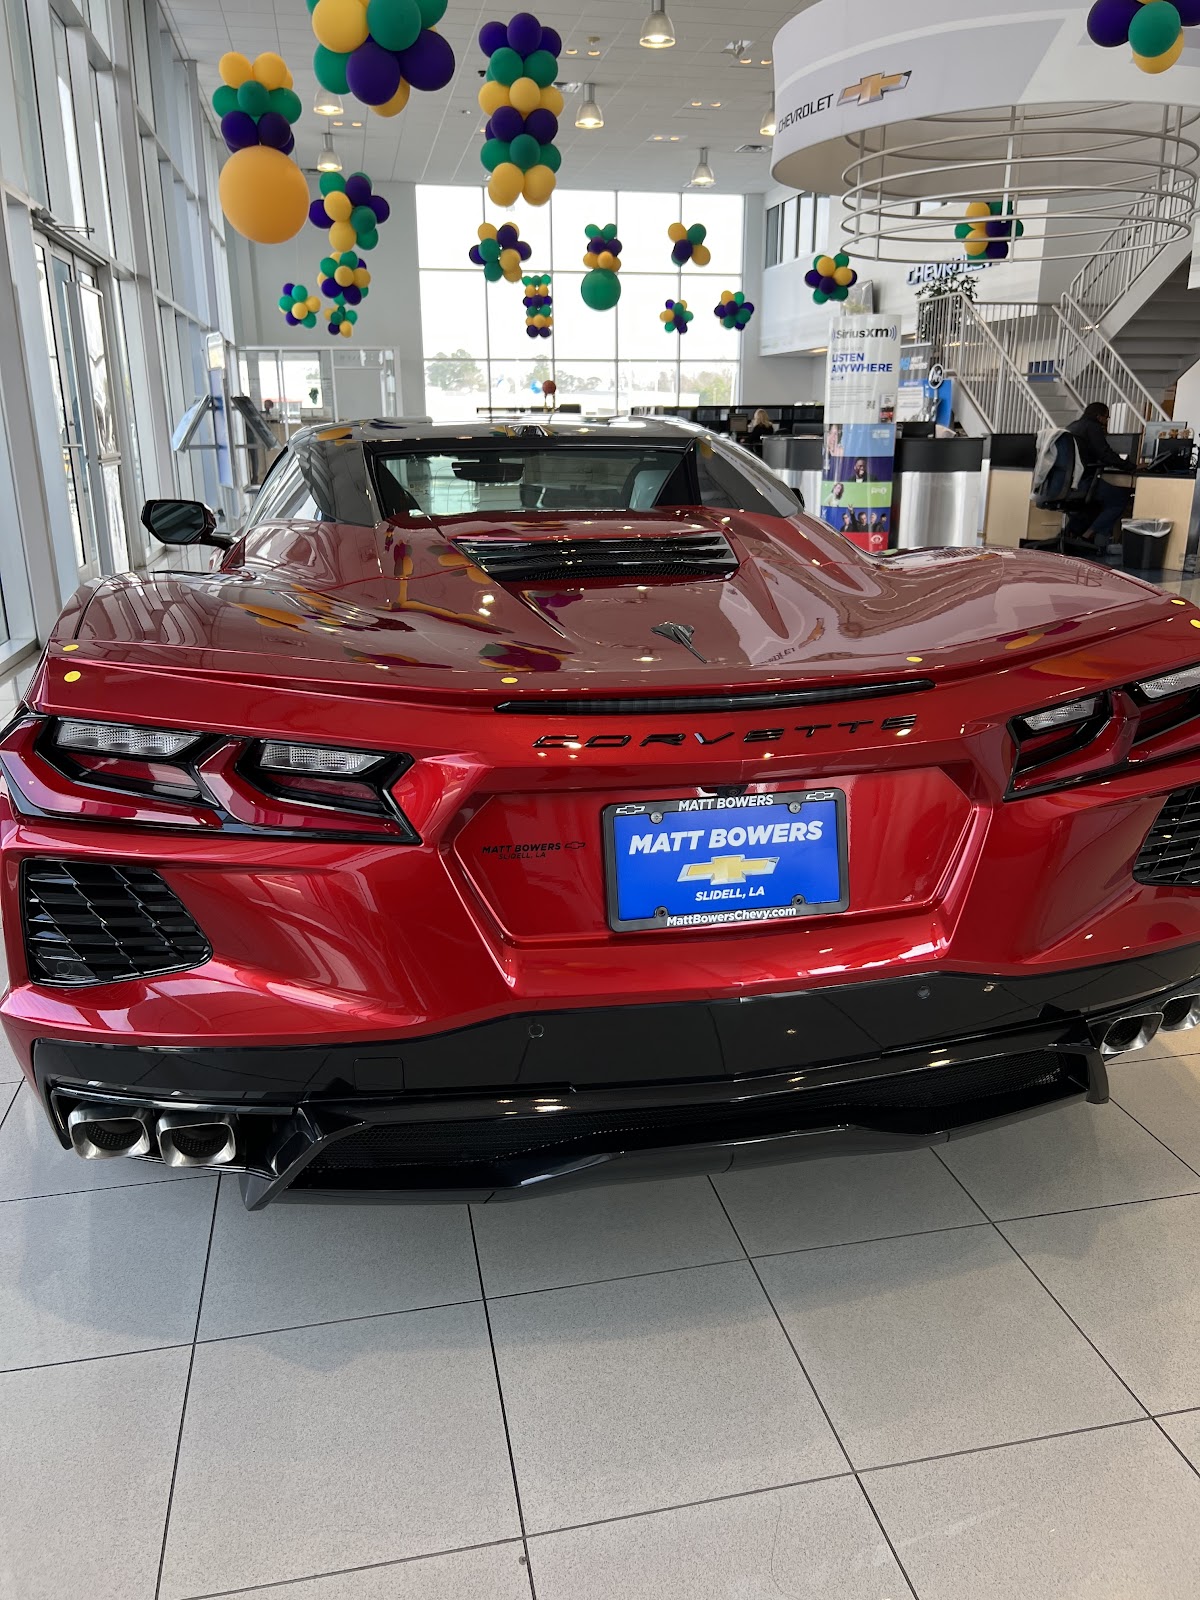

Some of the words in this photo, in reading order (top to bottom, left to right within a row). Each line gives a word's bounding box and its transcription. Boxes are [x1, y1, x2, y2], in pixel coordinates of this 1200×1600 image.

[778, 93, 834, 133] CHEVROLET
[832, 353, 865, 363] LISTEN
[831, 363, 893, 373] ANYWHERE
[532, 713, 917, 748] CORVETTE
[678, 798, 715, 812] MATT
[716, 794, 774, 809] BOWERS
[628, 830, 705, 855] MATT
[708, 820, 824, 849] BOWERS
[482, 845, 513, 854] MATT
[514, 842, 561, 853] BOWERS
[498, 852, 533, 860] SLIDELL,
[695, 887, 746, 902] SLIDELL,
[749, 886, 765, 897] LA
[666, 906, 797, 927] MattBowersChevy.com
